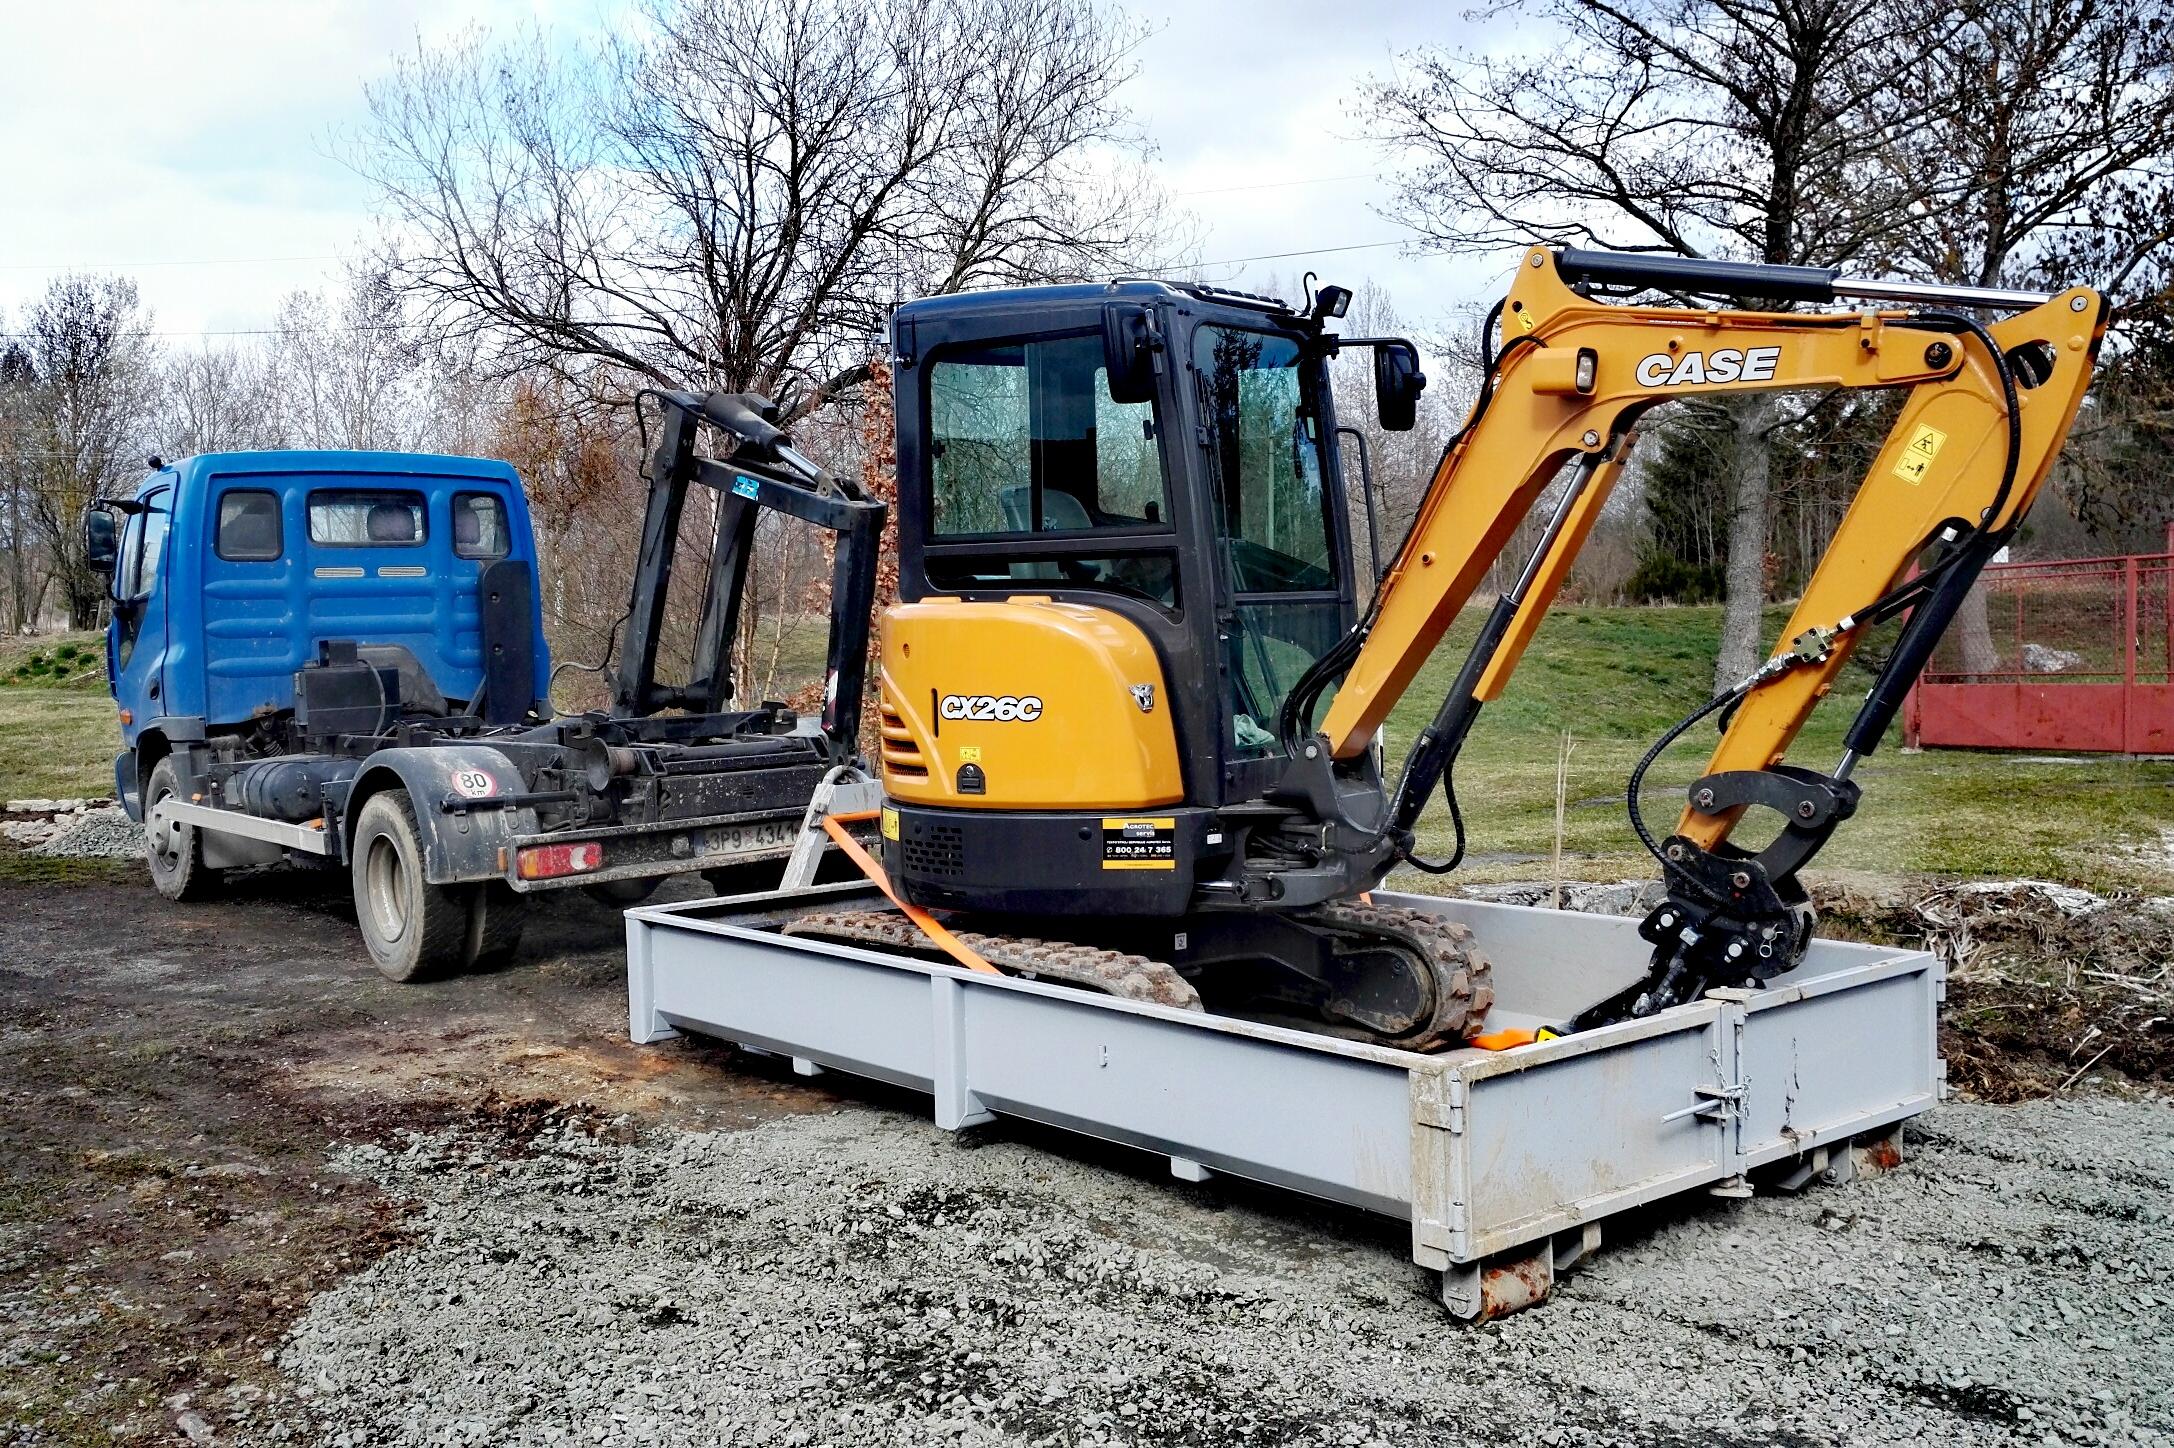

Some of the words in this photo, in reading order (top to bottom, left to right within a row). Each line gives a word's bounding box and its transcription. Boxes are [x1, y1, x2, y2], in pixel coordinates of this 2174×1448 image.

[1636, 346, 1782, 387] CASE
[940, 695, 1043, 722] CX26C
[462, 773, 487, 789] 80
[710, 829, 741, 851] 3P9
[755, 823, 795, 845] 4341
